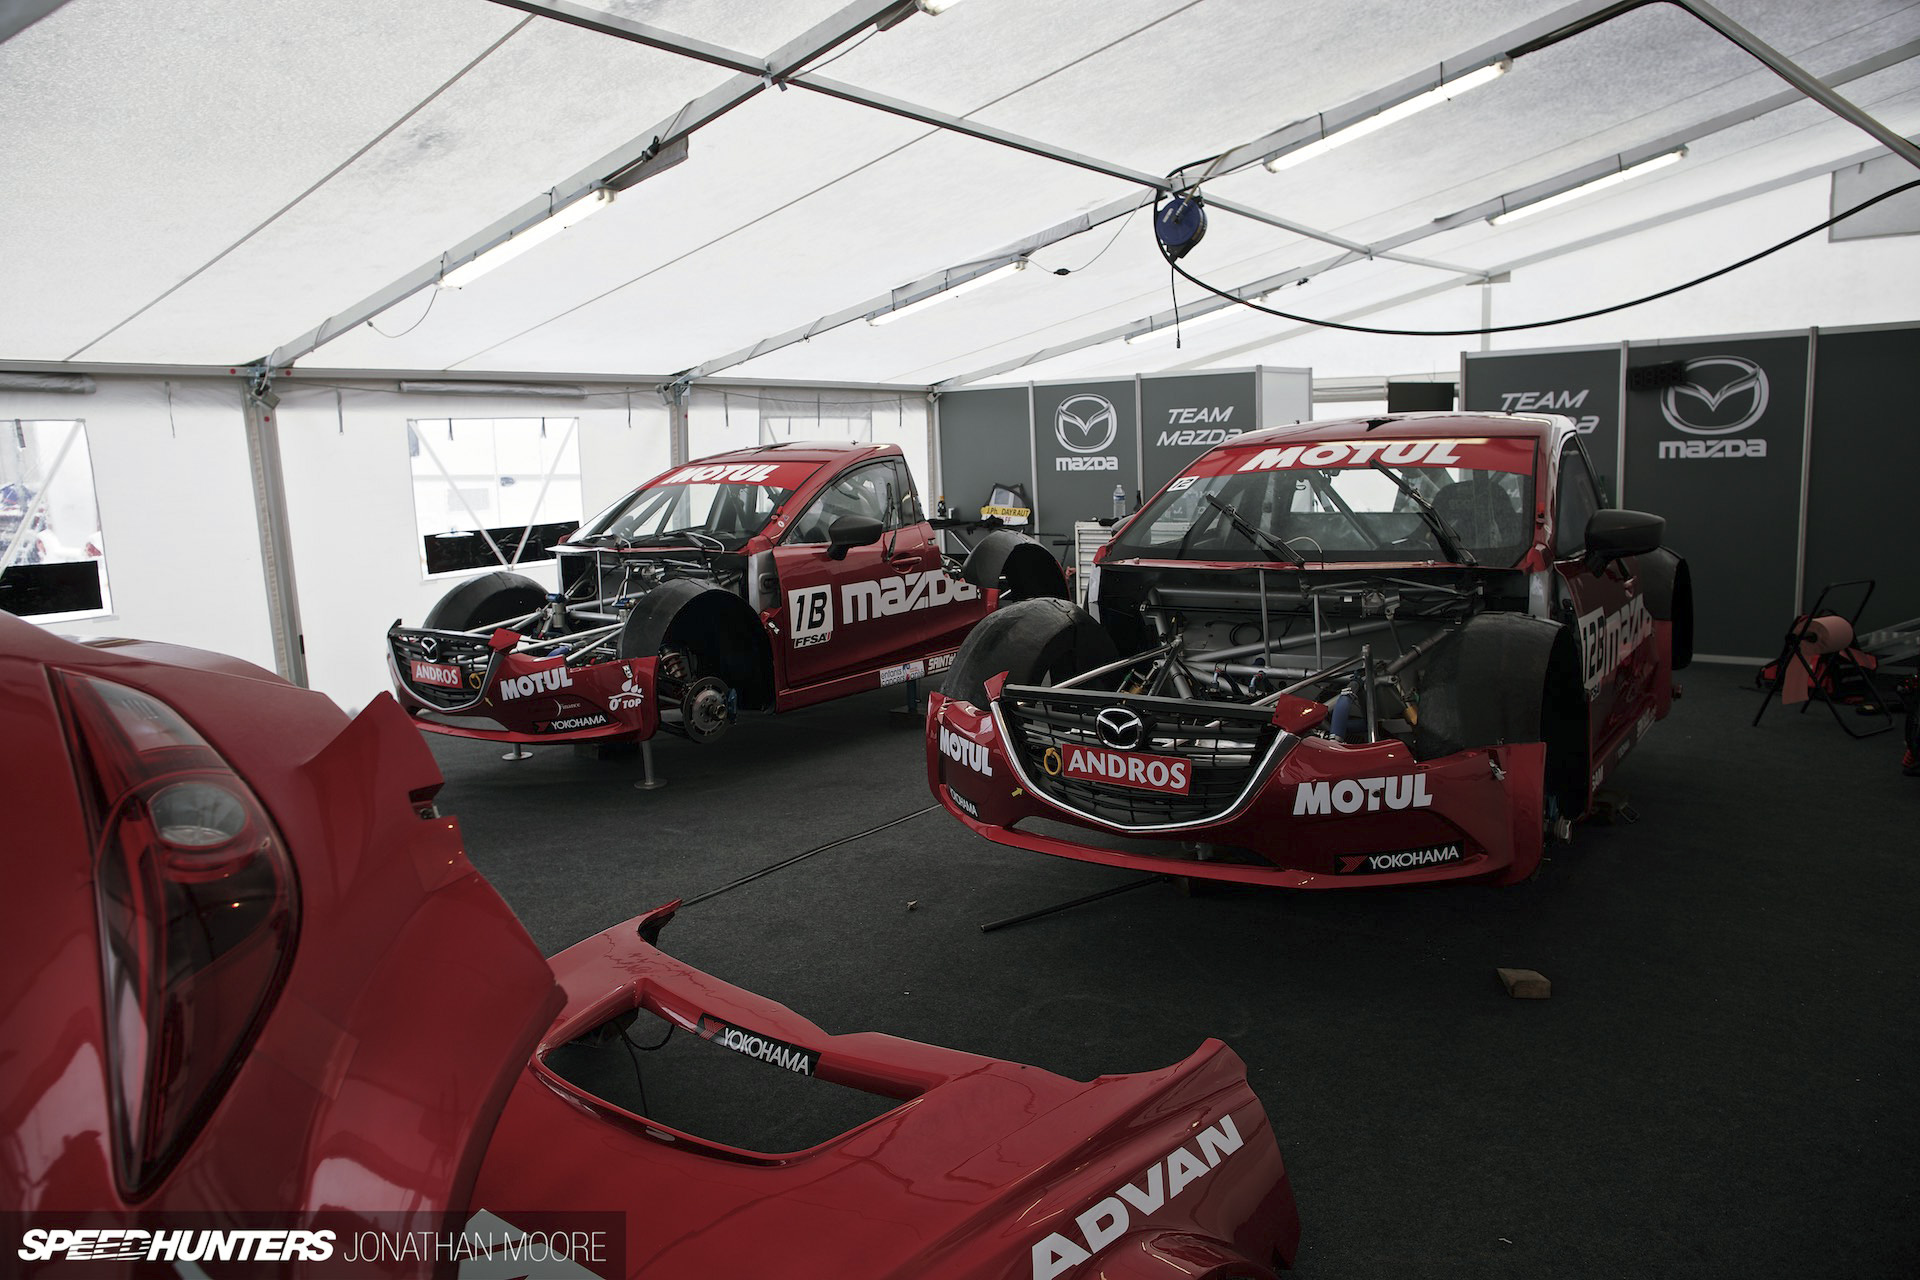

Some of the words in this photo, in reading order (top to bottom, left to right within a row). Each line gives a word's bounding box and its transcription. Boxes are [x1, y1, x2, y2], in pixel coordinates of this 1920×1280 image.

[1168, 401, 1234, 424] TEAM
[1501, 389, 1590, 411] TEAM
[1237, 441, 1461, 472] MOTUL
[660, 464, 781, 485] MOTUL
[796, 591, 828, 632] 1B
[795, 632, 828, 648] FFSA
[415, 664, 459, 685] ANDROS
[500, 666, 573, 701] MOTUL
[550, 714, 607, 731] YOKOHAMA
[940, 725, 993, 777] MOTUL
[1067, 749, 1187, 789] ANDROS
[1293, 773, 1434, 816] MOTUL
[1369, 845, 1460, 870] YOKOHAMA
[723, 1027, 809, 1076] YOKOHAMA
[1031, 1114, 1244, 1280] ADVAN
